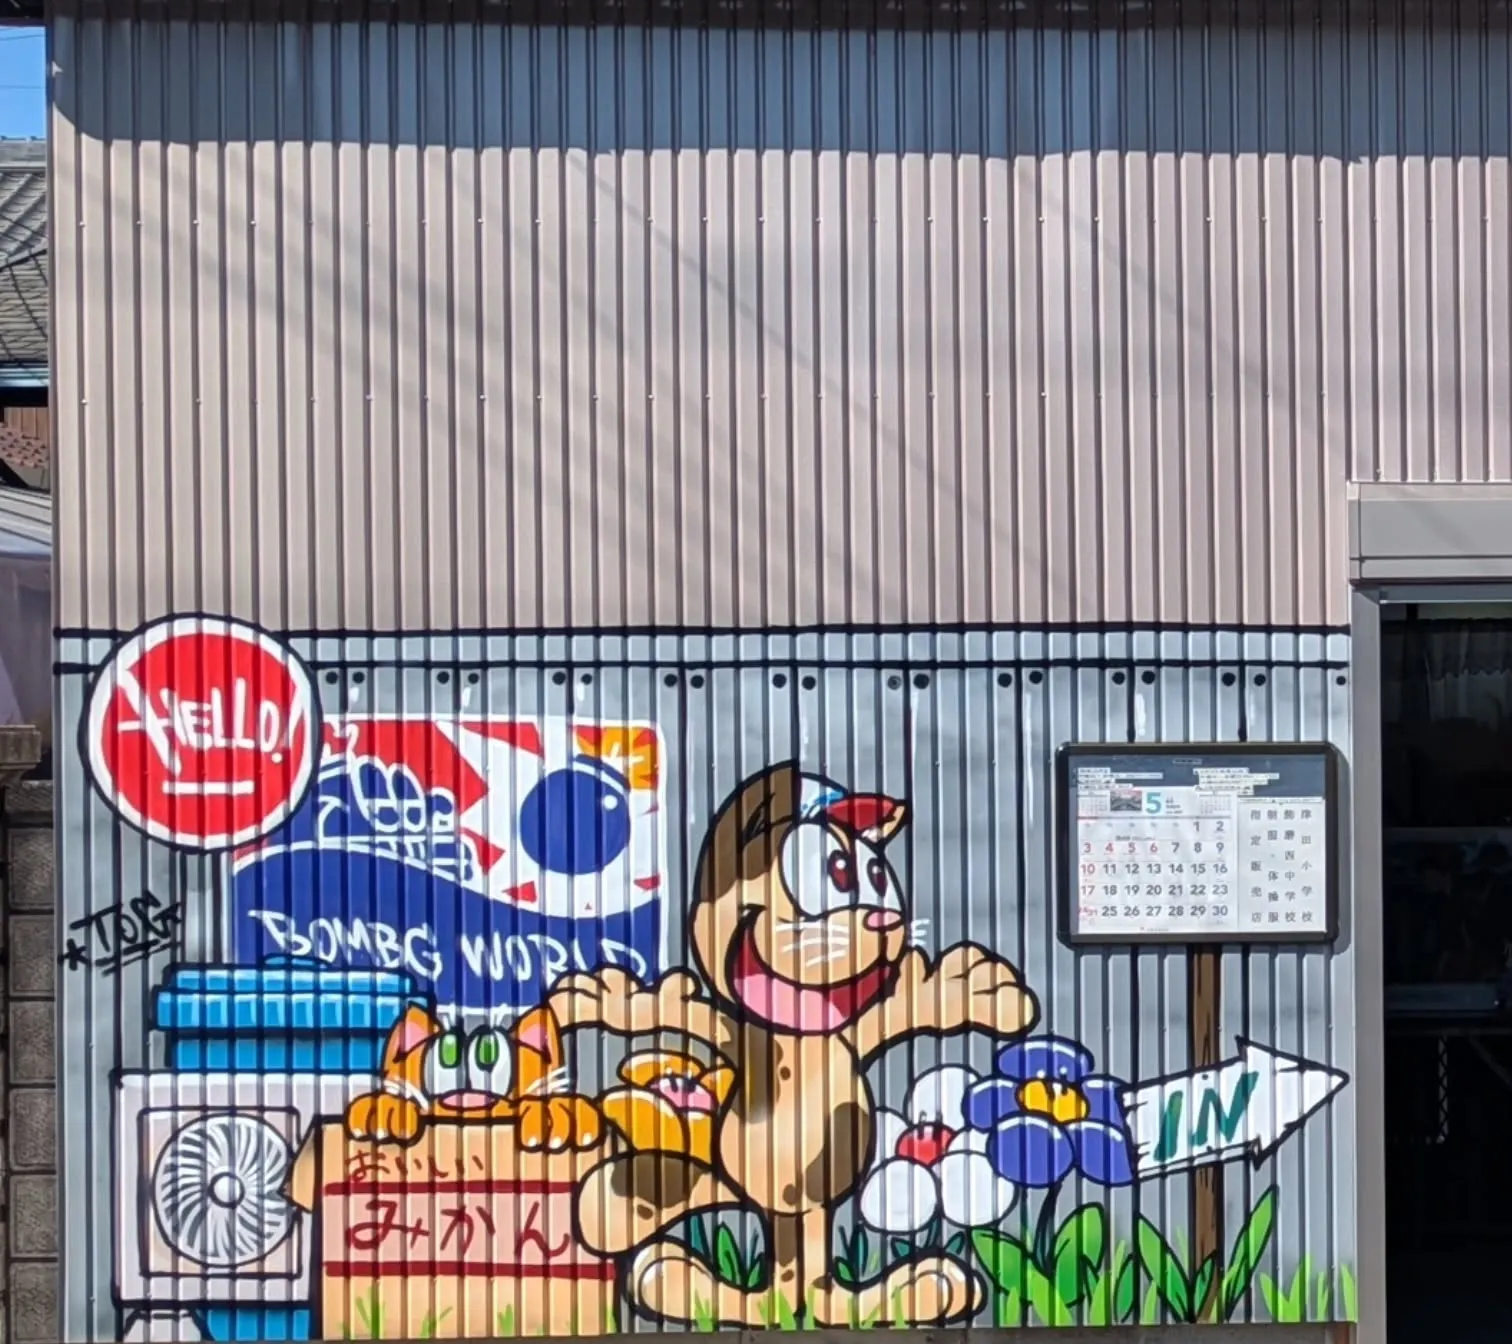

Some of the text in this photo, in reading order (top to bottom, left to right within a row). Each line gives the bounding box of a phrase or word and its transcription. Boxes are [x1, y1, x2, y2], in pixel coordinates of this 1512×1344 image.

[1145, 791, 1162, 814] 5
[1193, 821, 1200, 833] 1
[1215, 821, 1225, 833] 2
[1084, 842, 1225, 854] 3 4 5 6 7 8 9
[1081, 863, 1228, 874] 10 11 12 13 14 15 16
[1081, 884, 1229, 896] 17 18 19 20 21 22 23
[1101, 905, 1118, 917] 25
[1123, 905, 1140, 917] 26
[1145, 905, 1162, 917] 27
[1168, 905, 1184, 917] 28
[1190, 905, 1206, 917] 29
[1212, 905, 1229, 917] 30
[1153, 1070, 1260, 1162] IN
[344, 1149, 484, 1183] おいしい
[345, 1198, 571, 1258] みかん
